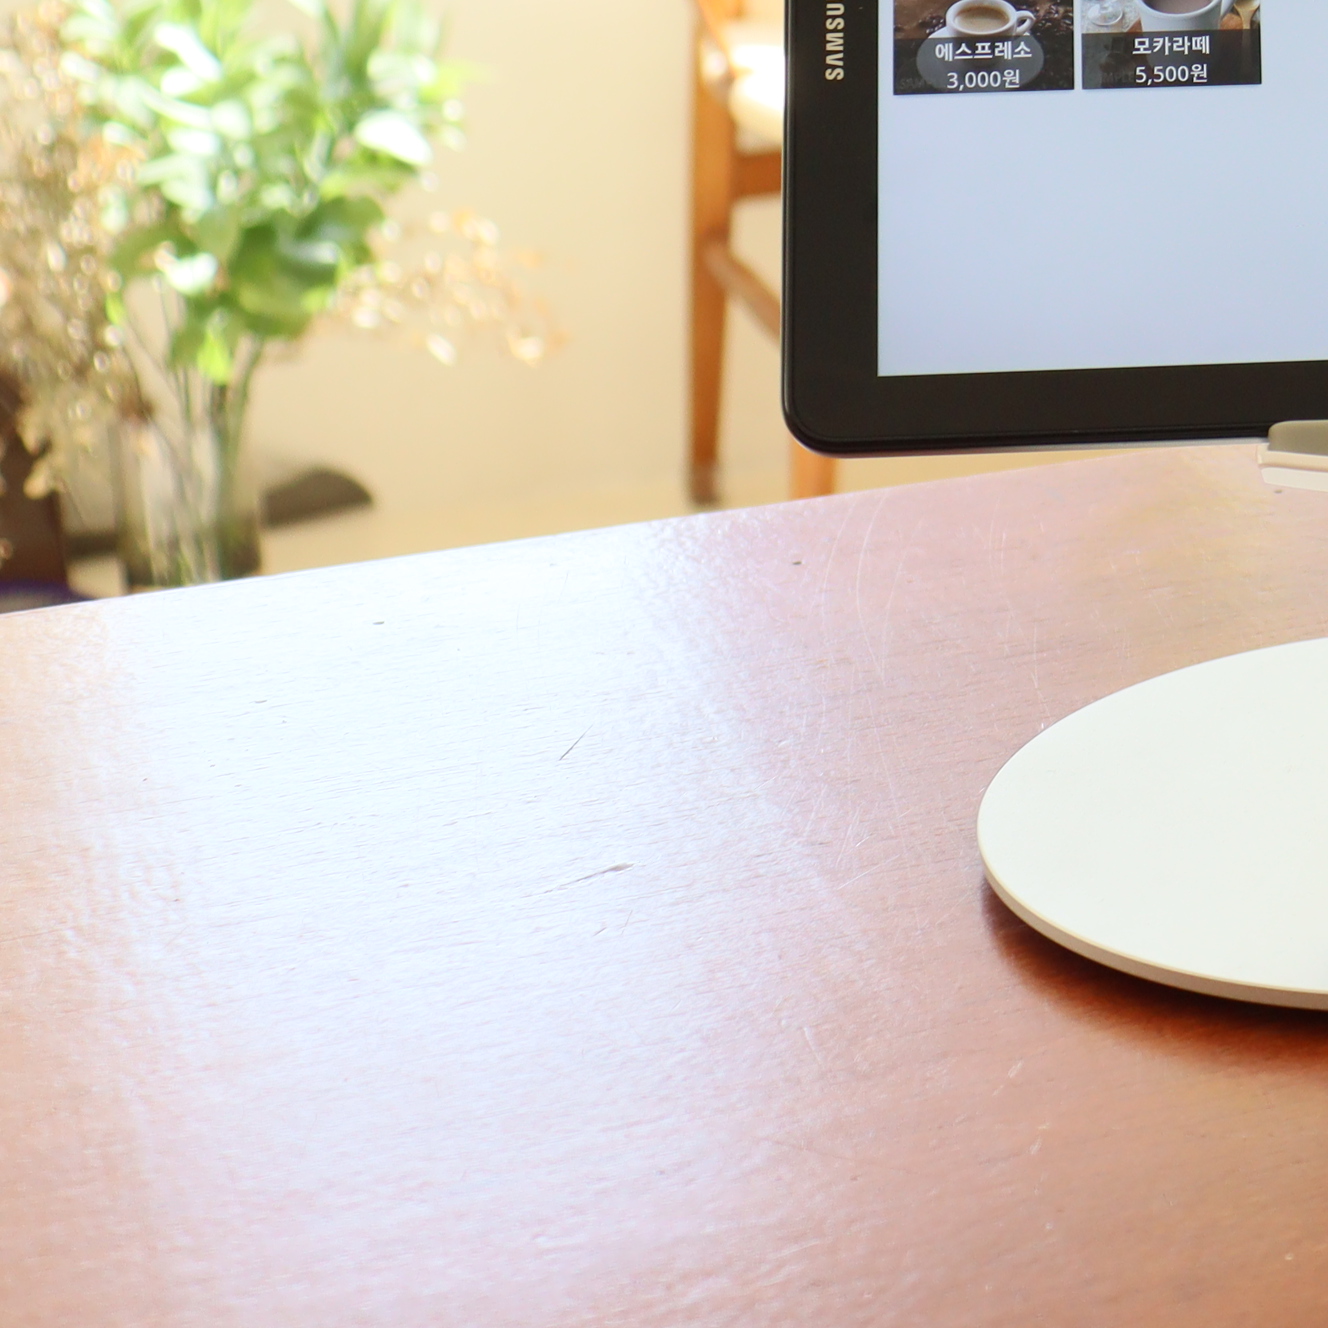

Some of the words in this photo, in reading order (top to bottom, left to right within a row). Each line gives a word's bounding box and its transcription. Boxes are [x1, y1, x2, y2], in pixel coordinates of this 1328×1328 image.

[935, 41, 1033, 62] 에스프레소
[1132, 35, 1210, 56] 모카라떼
[946, 69, 1021, 91] 3,000원
[1134, 63, 1209, 85] 5,500원
